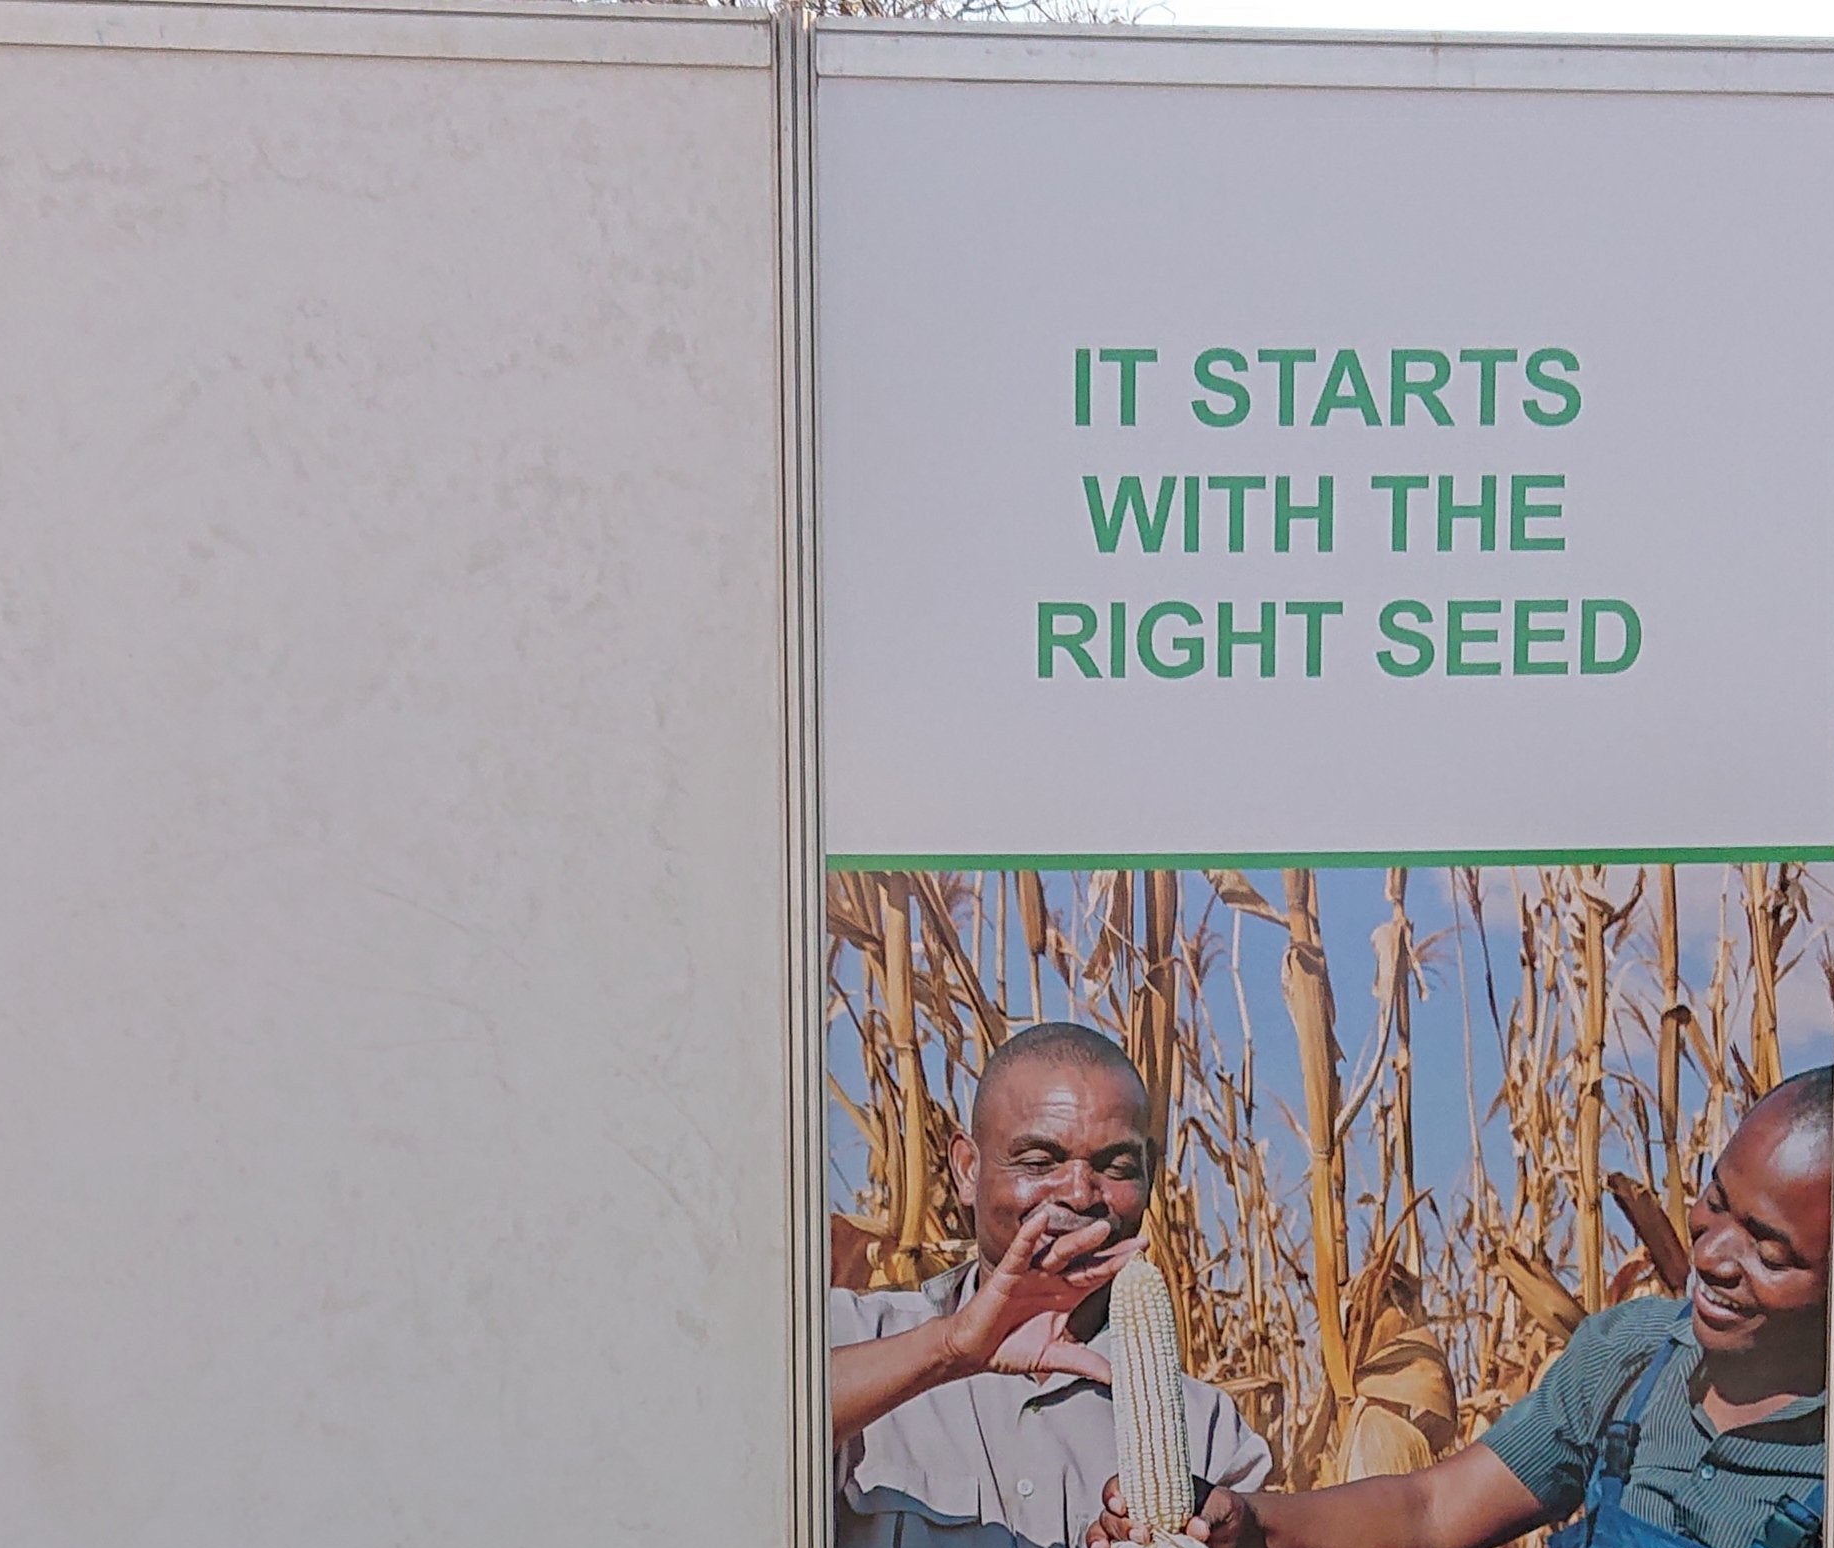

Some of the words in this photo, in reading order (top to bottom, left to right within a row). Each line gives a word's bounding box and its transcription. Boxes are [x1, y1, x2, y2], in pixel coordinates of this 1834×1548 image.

[1075, 348, 1157, 426] IT
[1191, 348, 1581, 428] STARTS
[1083, 475, 1334, 553] WITH
[1372, 474, 1565, 552] THE
[1037, 601, 1344, 679] RIGHT
[1376, 599, 1641, 677] SEED
